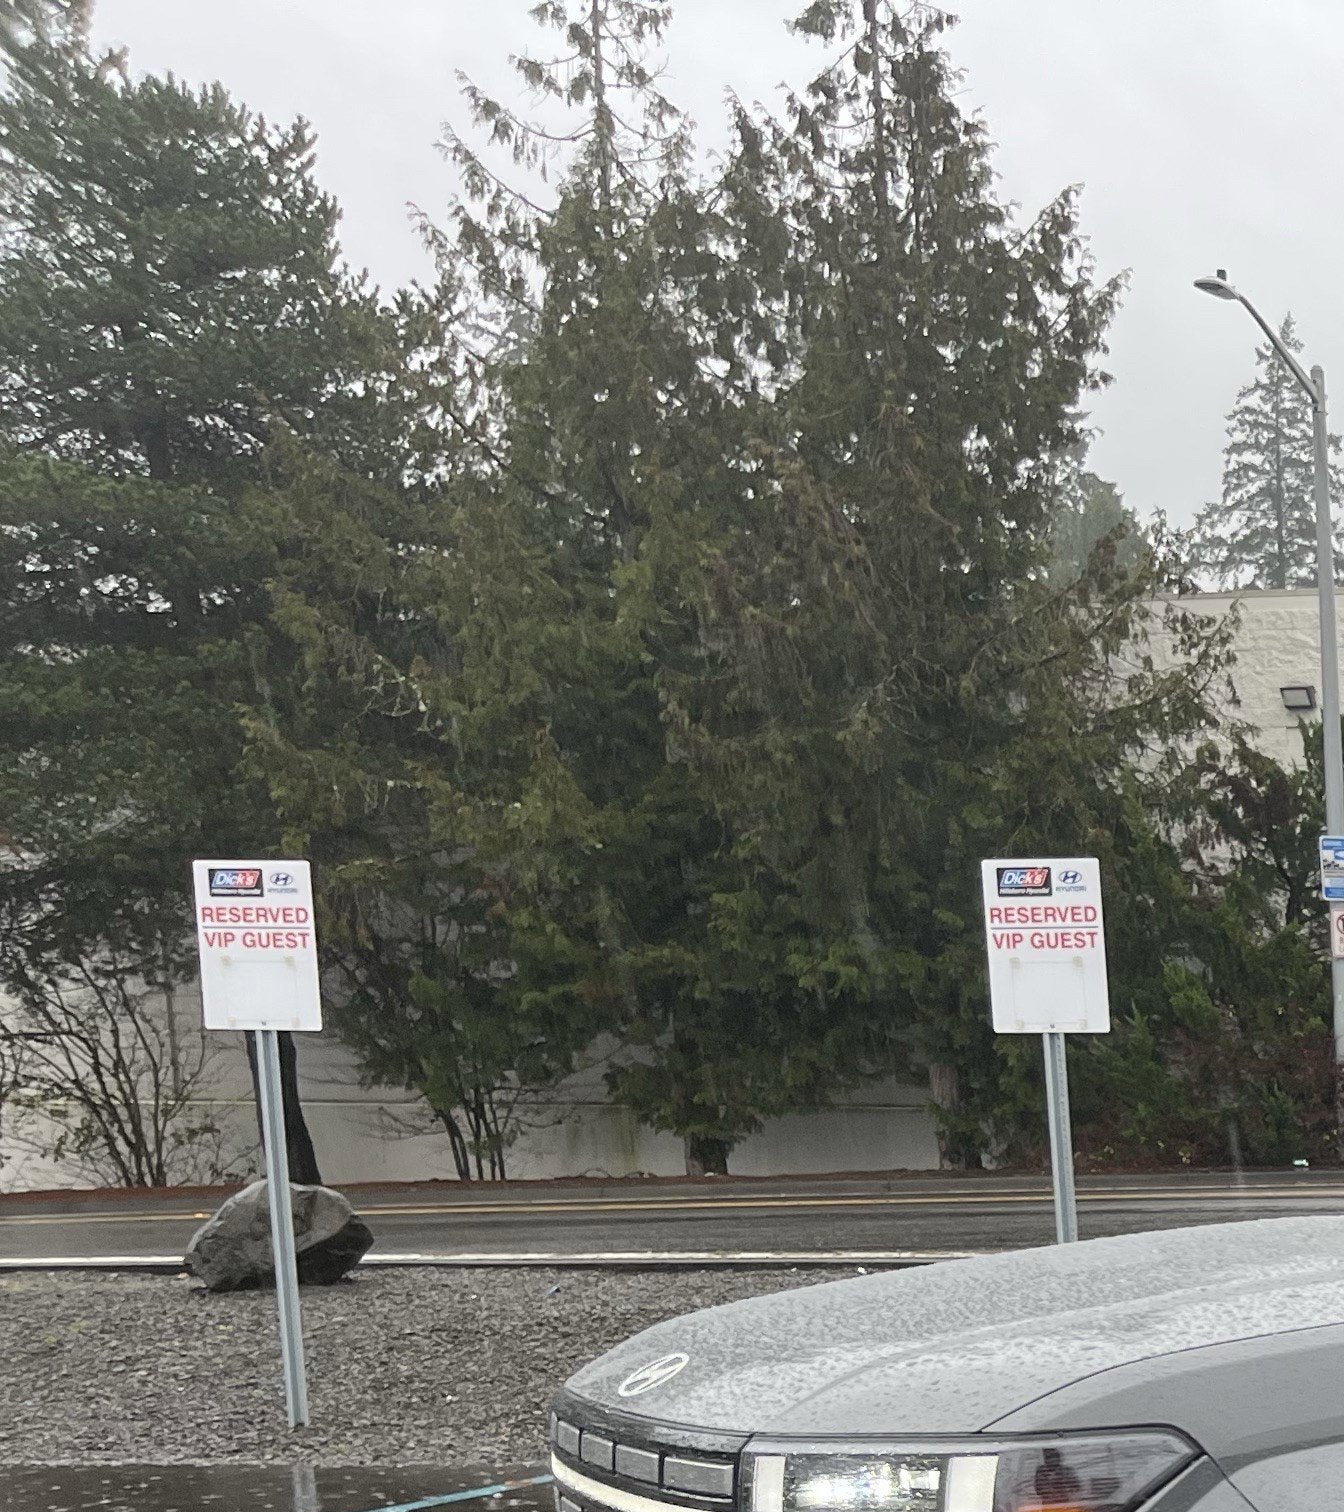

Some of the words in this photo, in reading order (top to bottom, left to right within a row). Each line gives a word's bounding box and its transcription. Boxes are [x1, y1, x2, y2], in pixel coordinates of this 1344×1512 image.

[1004, 871, 1044, 885] Dick's
[201, 906, 309, 924] RESERVED
[990, 906, 1097, 924] RESERVED
[204, 932, 235, 949] VIP
[242, 932, 310, 949] GUEST
[992, 931, 1024, 949] VIP
[1030, 931, 1099, 949] GUEST
